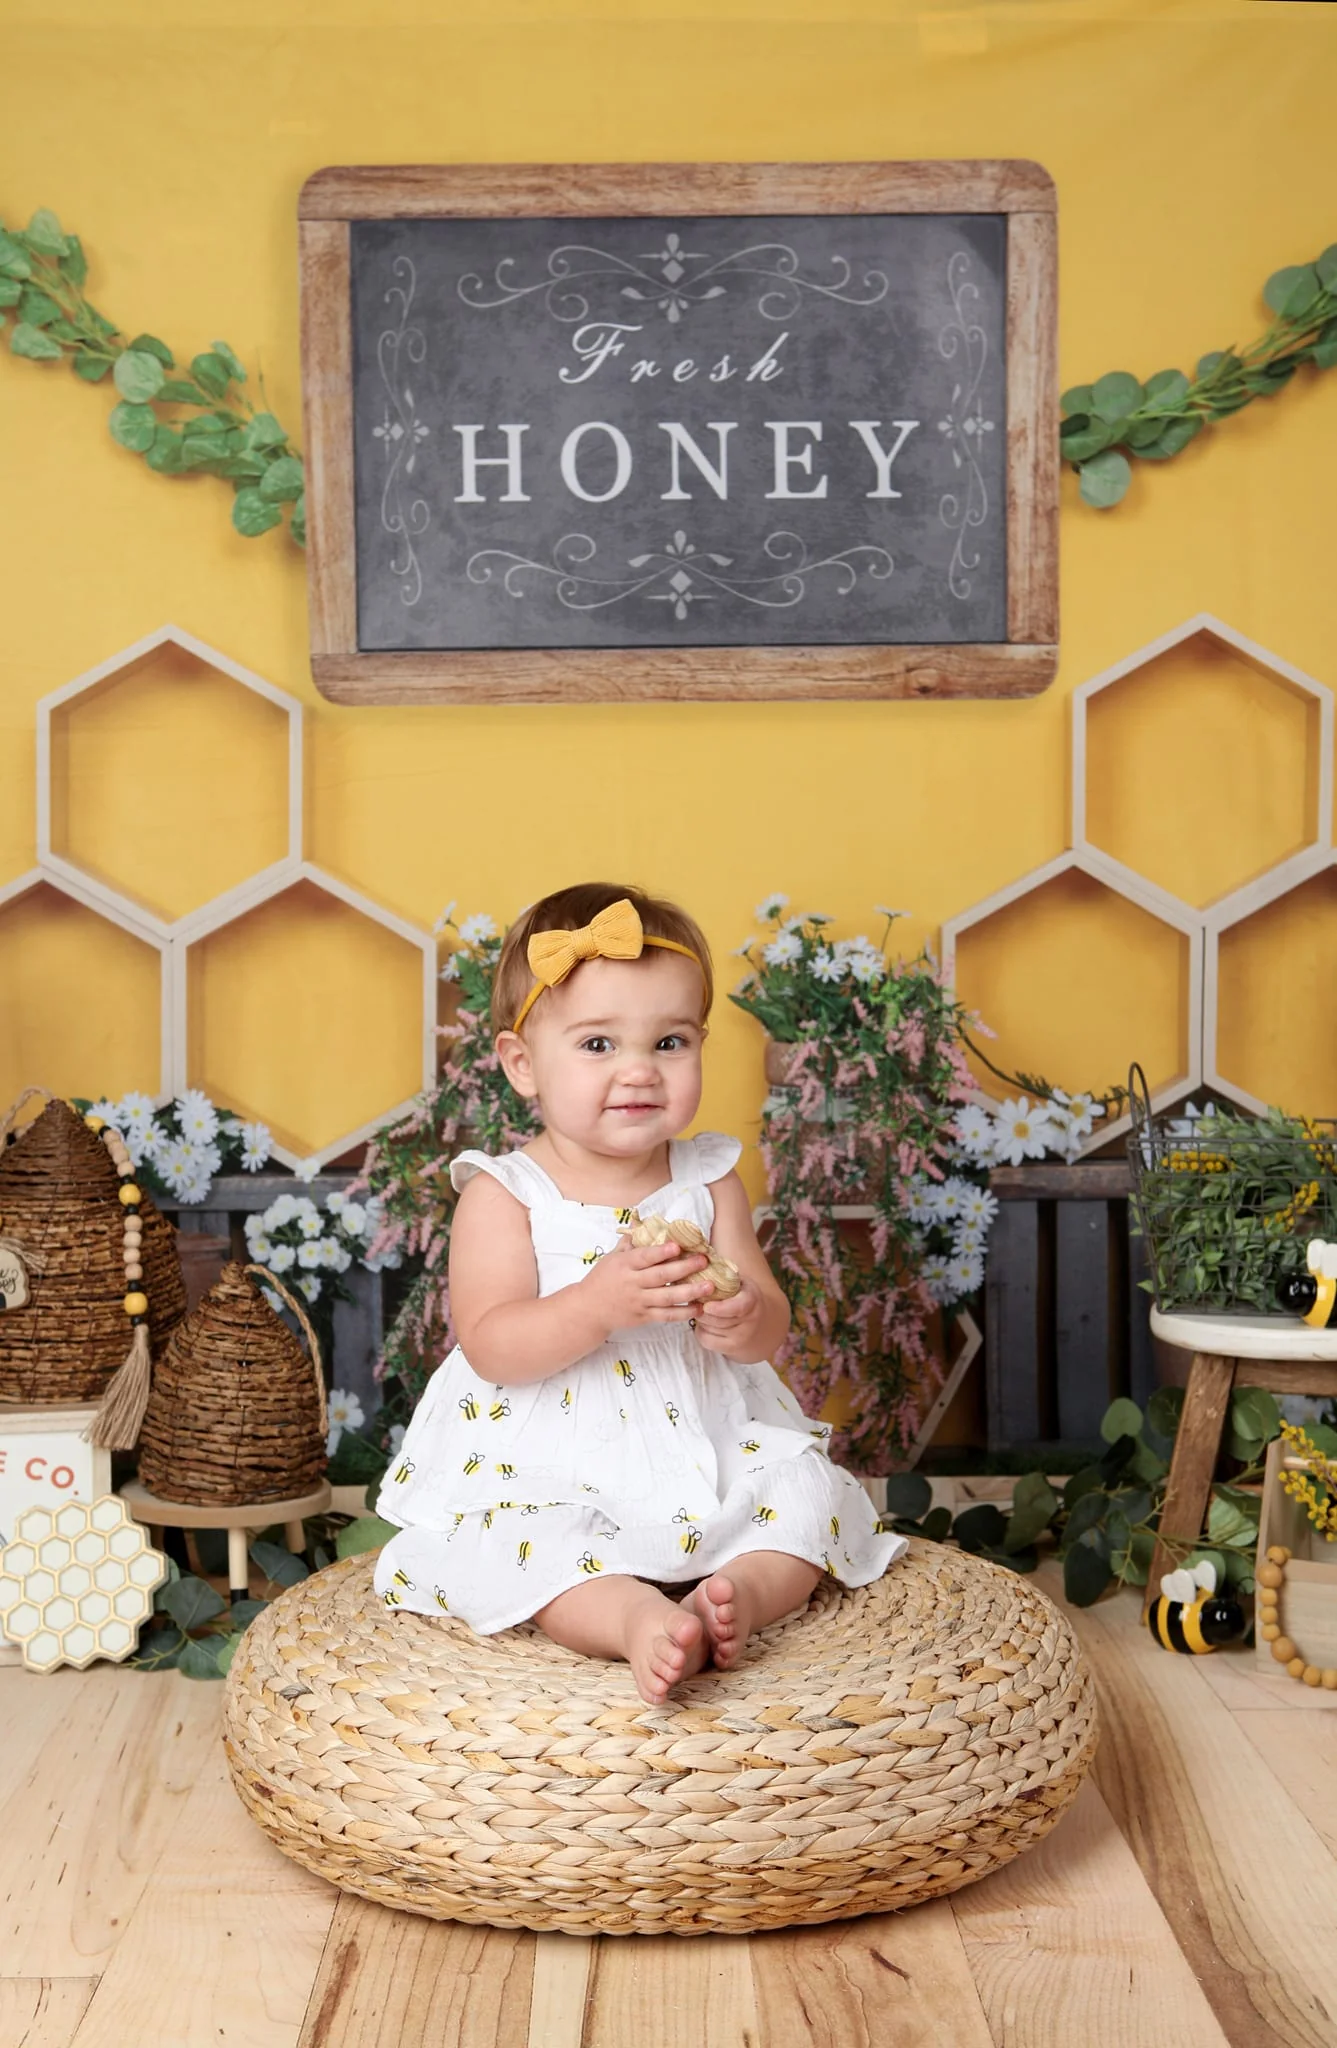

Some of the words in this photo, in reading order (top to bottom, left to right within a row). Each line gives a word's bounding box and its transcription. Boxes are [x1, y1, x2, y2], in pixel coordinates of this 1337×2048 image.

[558, 322, 789, 384] Fresh
[453, 421, 920, 502] HONEY
[25, 1457, 79, 1496] CO.
